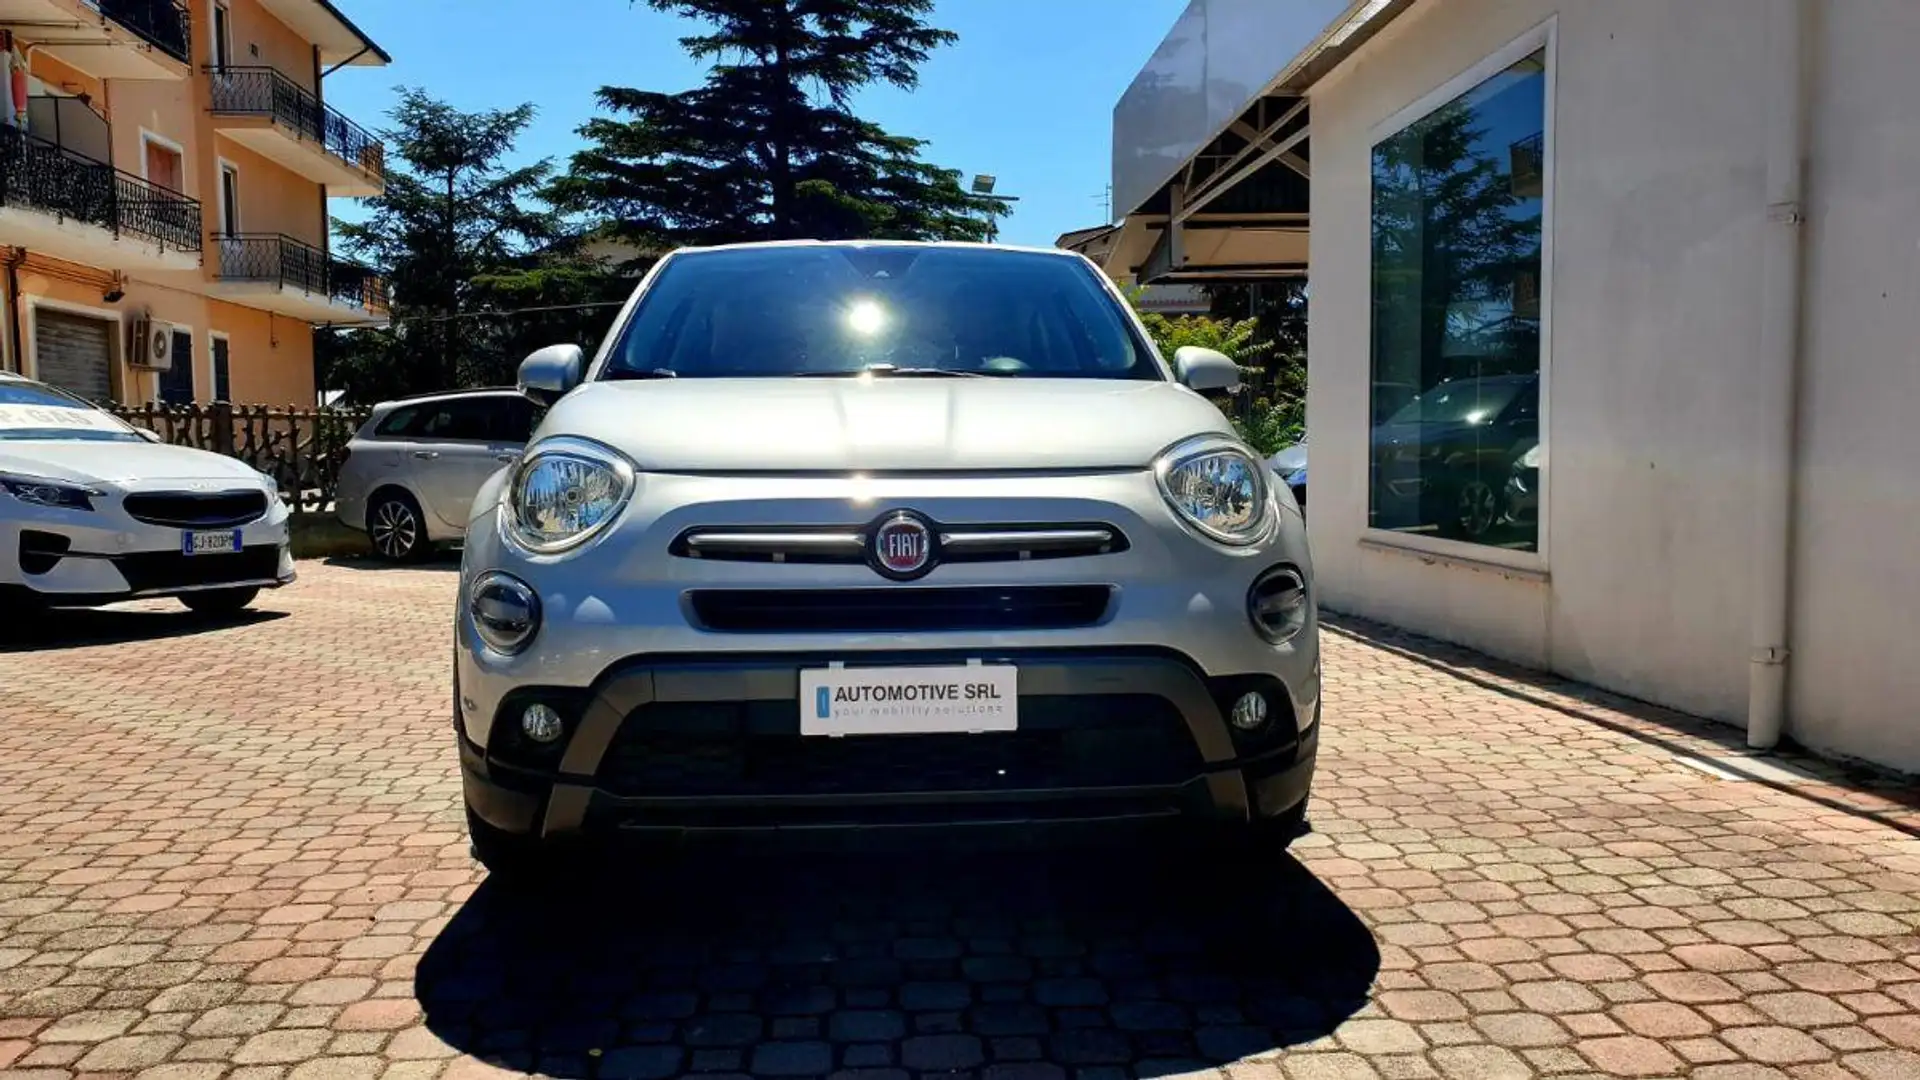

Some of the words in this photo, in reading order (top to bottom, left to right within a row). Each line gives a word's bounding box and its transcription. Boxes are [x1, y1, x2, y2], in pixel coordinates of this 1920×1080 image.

[888, 533, 919, 557] FIAT
[834, 684, 959, 702] AUTOMOTIVE
[964, 683, 1002, 699] SRL
[834, 707, 865, 720] your
[869, 704, 930, 718] mobility
[934, 704, 1004, 715] solutions
